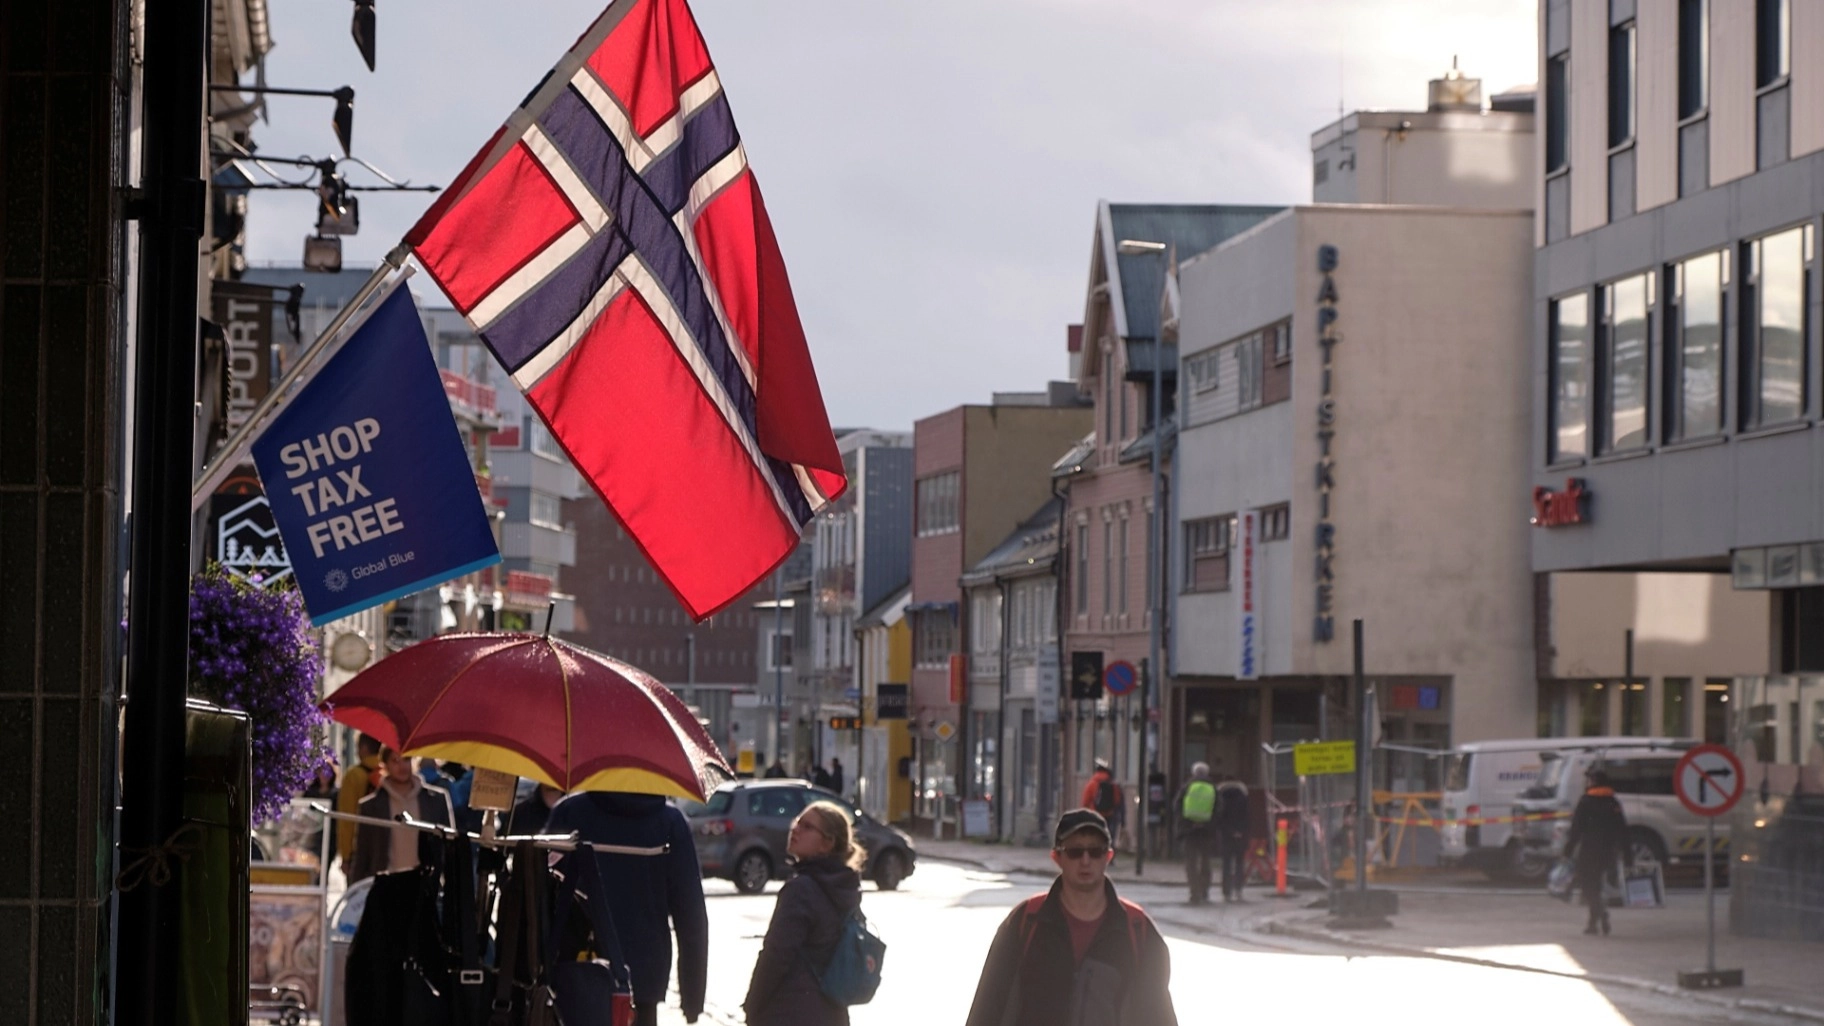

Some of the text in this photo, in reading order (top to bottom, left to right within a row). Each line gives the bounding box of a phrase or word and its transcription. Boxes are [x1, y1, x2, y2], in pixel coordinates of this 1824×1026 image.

[280, 417, 380, 479] SHOP
[1314, 243, 1339, 644] BAPTISTKIRKEN
[291, 465, 372, 517] TAX
[306, 498, 405, 558] FREE
[351, 551, 415, 580] Global Blue
